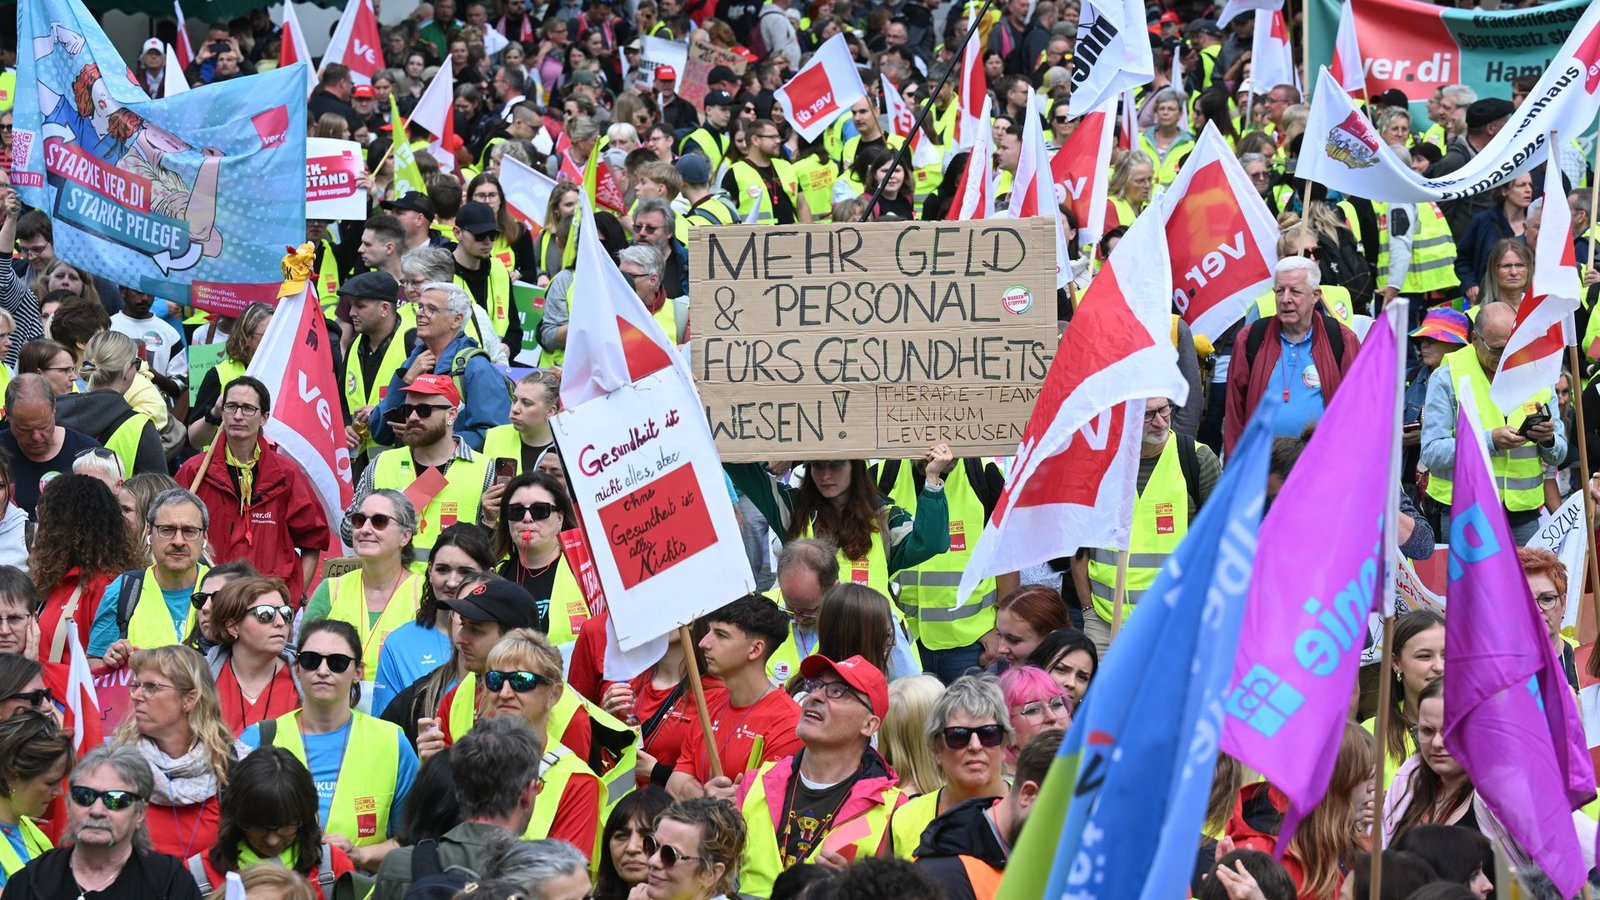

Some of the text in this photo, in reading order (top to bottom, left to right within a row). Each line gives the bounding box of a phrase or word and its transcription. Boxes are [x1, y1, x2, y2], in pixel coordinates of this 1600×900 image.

[46, 143, 144, 208] STARKE VER.DI
[67, 188, 182, 250] STARKE PFLEGE
[708, 225, 1026, 280] MEHR GELD
[714, 280, 1000, 332] & PERSONAL
[703, 337, 805, 383] FÜRS
[578, 409, 680, 477] Gesundheit ist
[887, 422, 1028, 443] LEVERKUSEN
[595, 477, 623, 503] nicht
[656, 446, 681, 471] aber
[624, 487, 655, 512] ohne
[611, 501, 676, 546] Gesundheit
[681, 490, 694, 507] ist
[638, 537, 687, 582] Nichts
